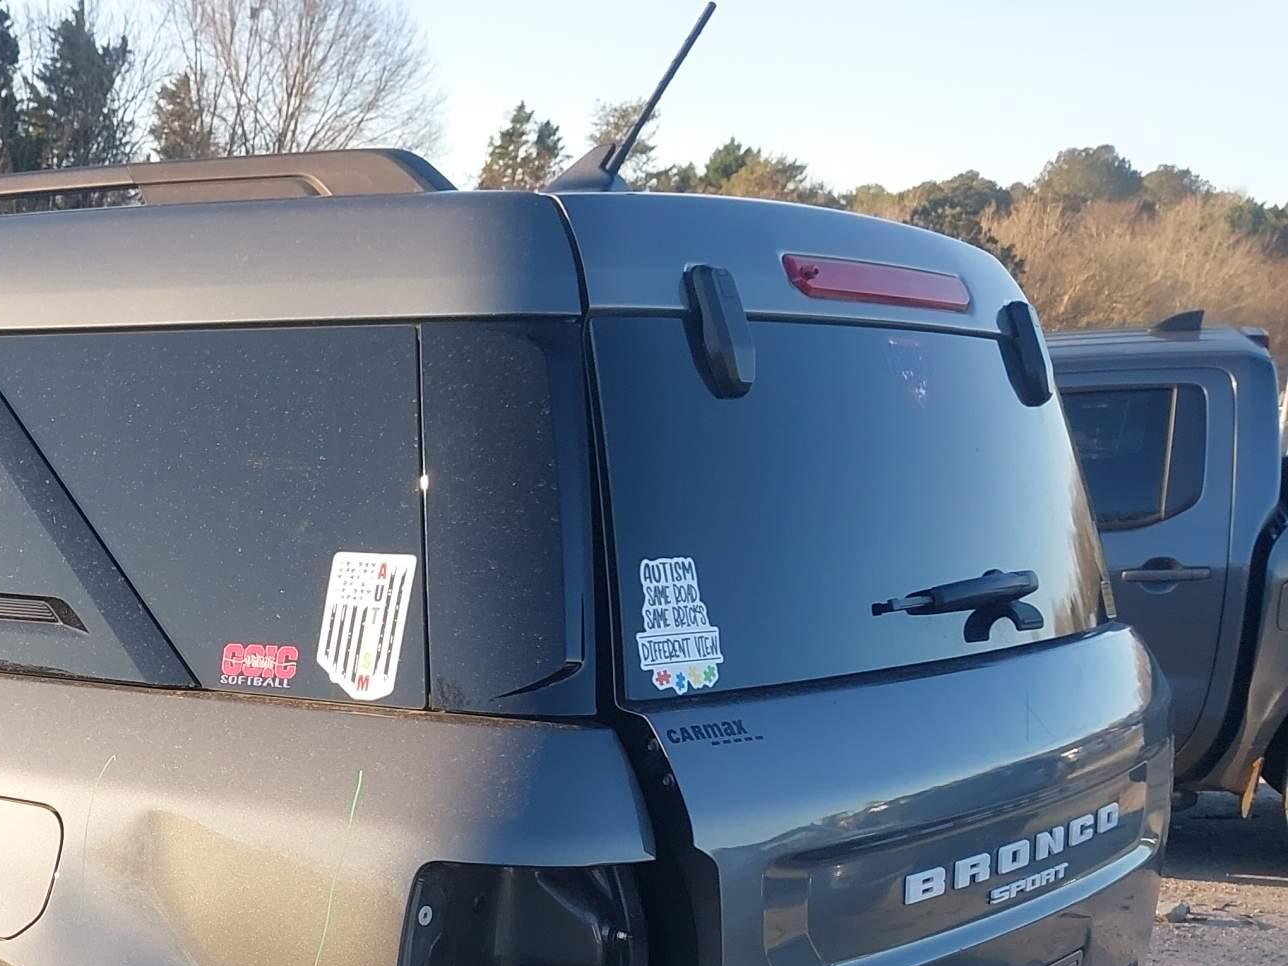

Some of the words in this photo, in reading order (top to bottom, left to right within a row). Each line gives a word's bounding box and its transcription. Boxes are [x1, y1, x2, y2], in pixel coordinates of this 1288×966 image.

[643, 561, 696, 584] AUTISM
[646, 584, 672, 607] SAME
[673, 584, 698, 605] ROAD
[645, 606, 671, 630] SAME
[673, 603, 707, 629] BRICKS
[641, 637, 691, 662] DIFFERENT
[693, 634, 719, 658] VIEW
[219, 674, 291, 689] SOFTBALL
[902, 801, 1121, 906] BRONCO
[988, 861, 1070, 905] SPORT
